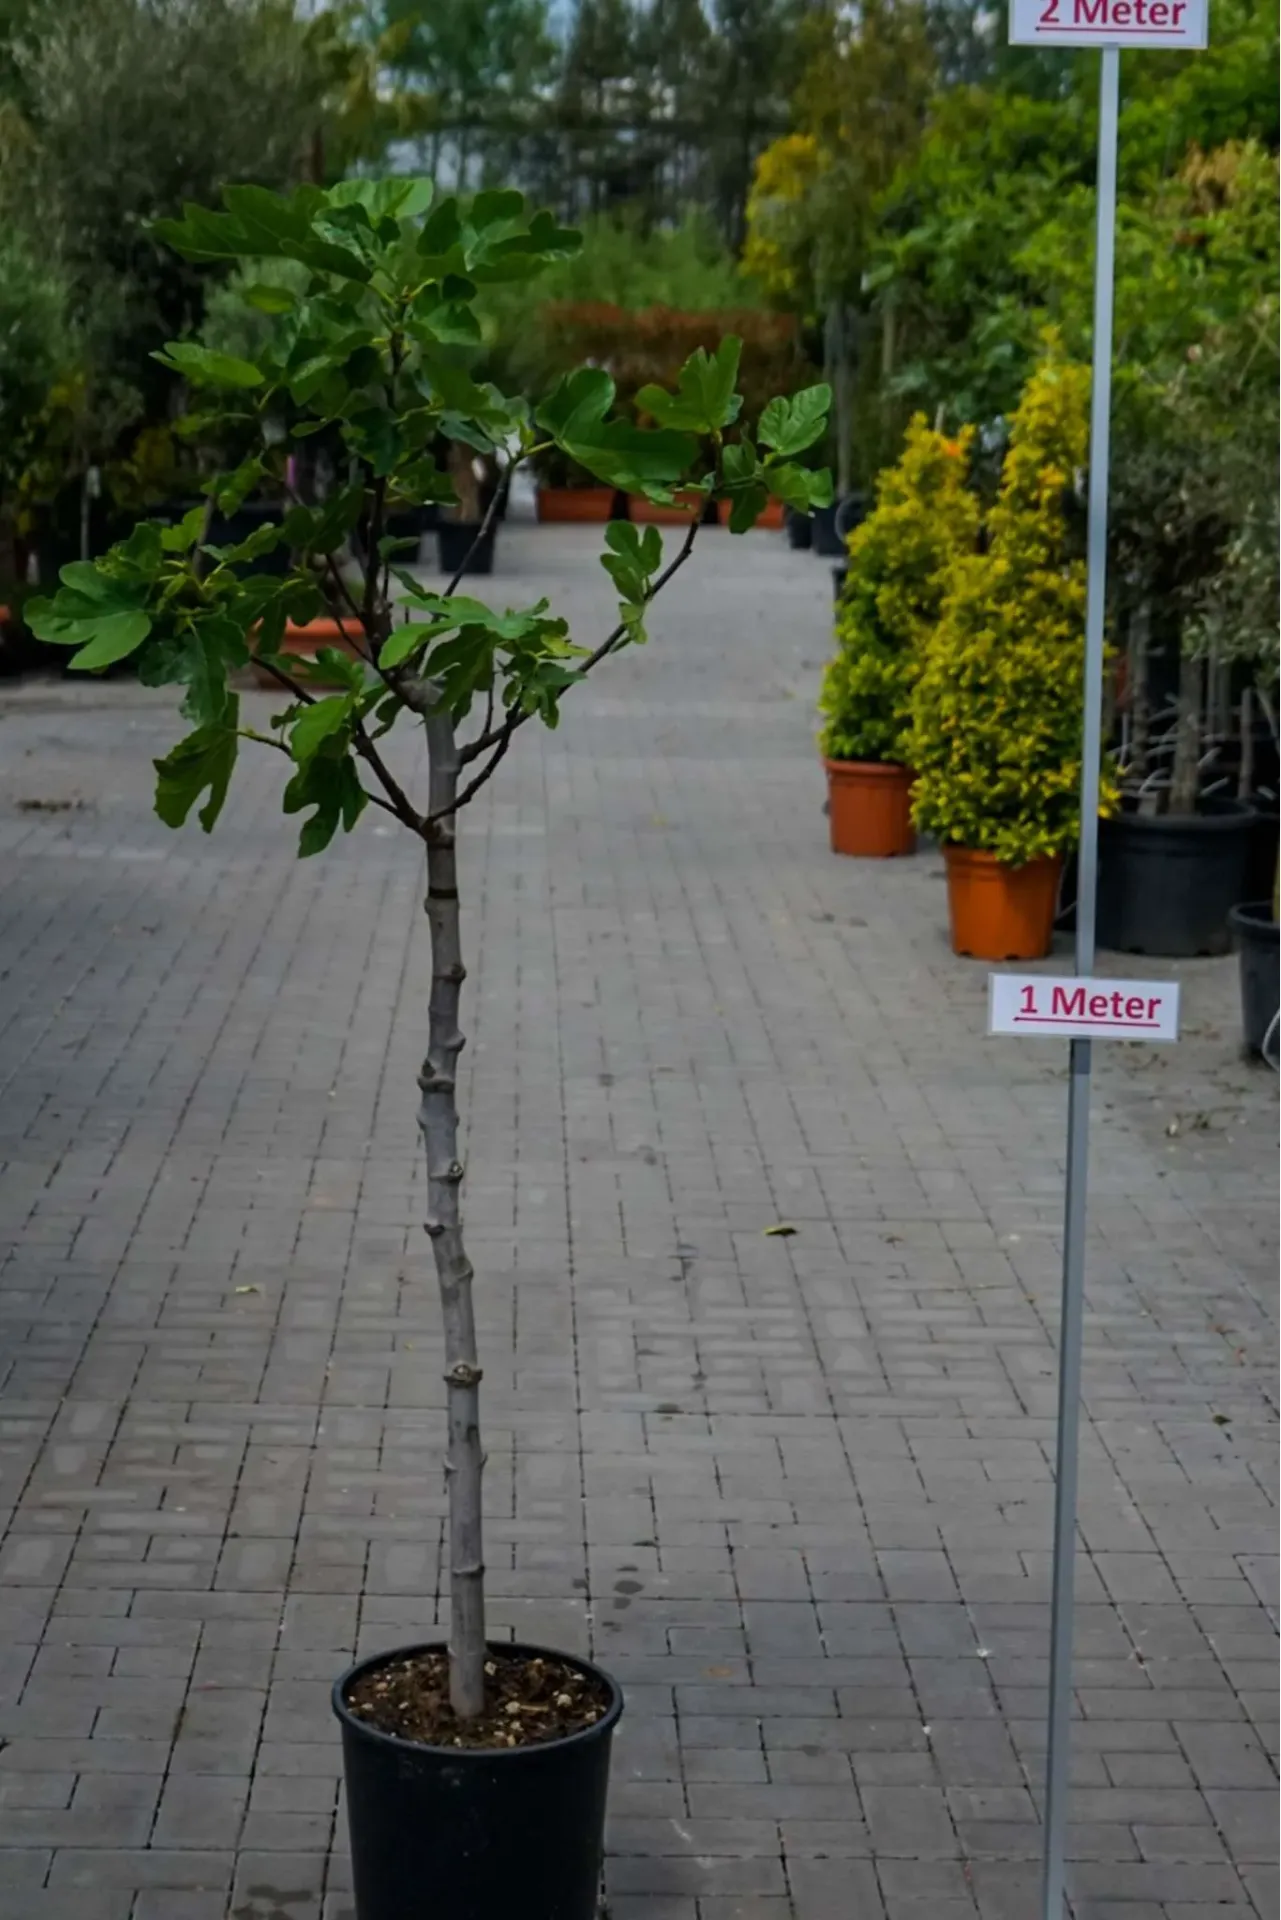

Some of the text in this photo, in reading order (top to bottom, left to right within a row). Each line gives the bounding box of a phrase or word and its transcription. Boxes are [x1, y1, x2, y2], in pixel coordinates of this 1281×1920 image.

[1040, 0, 1187, 25] 2 Meter
[1020, 985, 1162, 1019] 1 Meter
